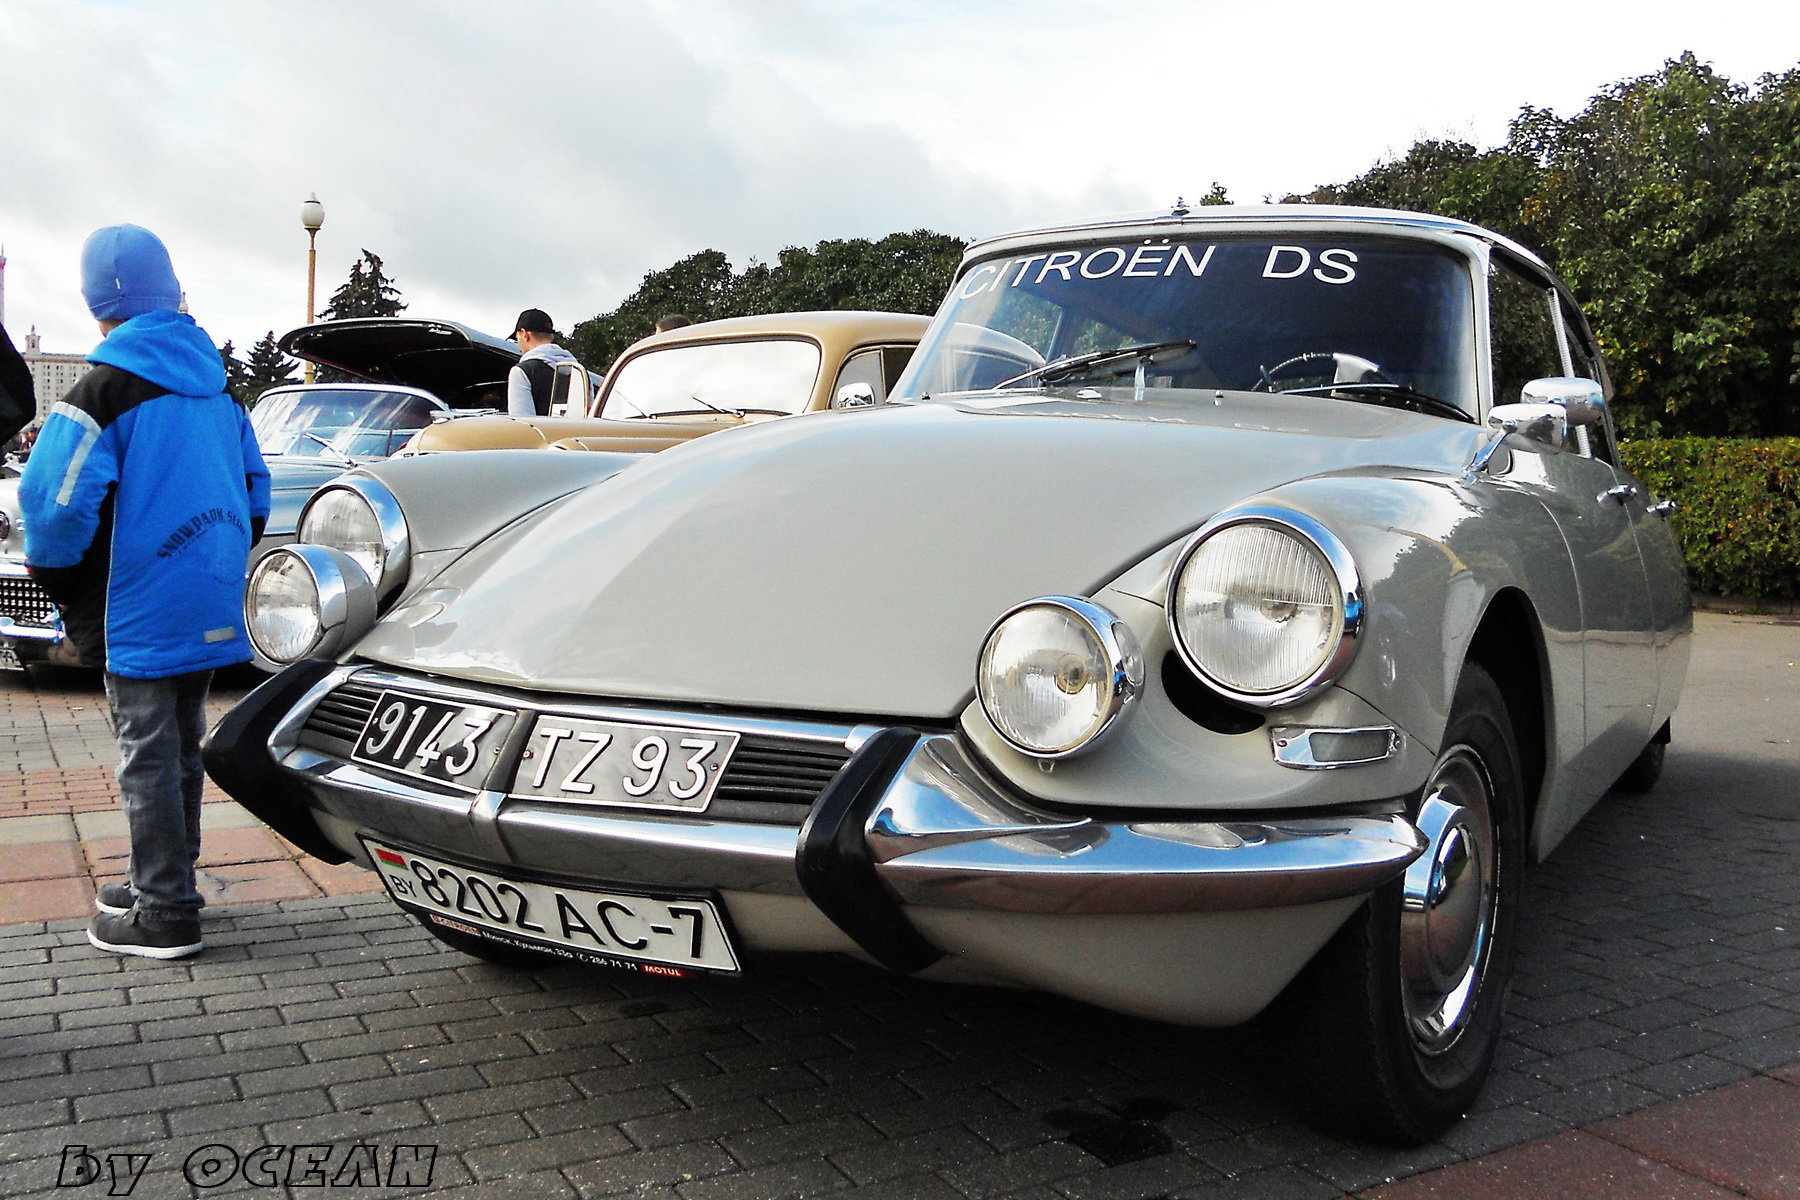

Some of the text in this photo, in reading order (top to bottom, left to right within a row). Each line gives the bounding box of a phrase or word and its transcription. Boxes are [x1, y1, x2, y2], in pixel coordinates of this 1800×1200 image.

[960, 238, 1358, 301] CITROËN DS
[365, 701, 718, 799] 9143 TZ 93
[389, 874, 417, 897] BY
[409, 859, 702, 959] 8202 AC-7
[644, 964, 682, 977] MOTUL
